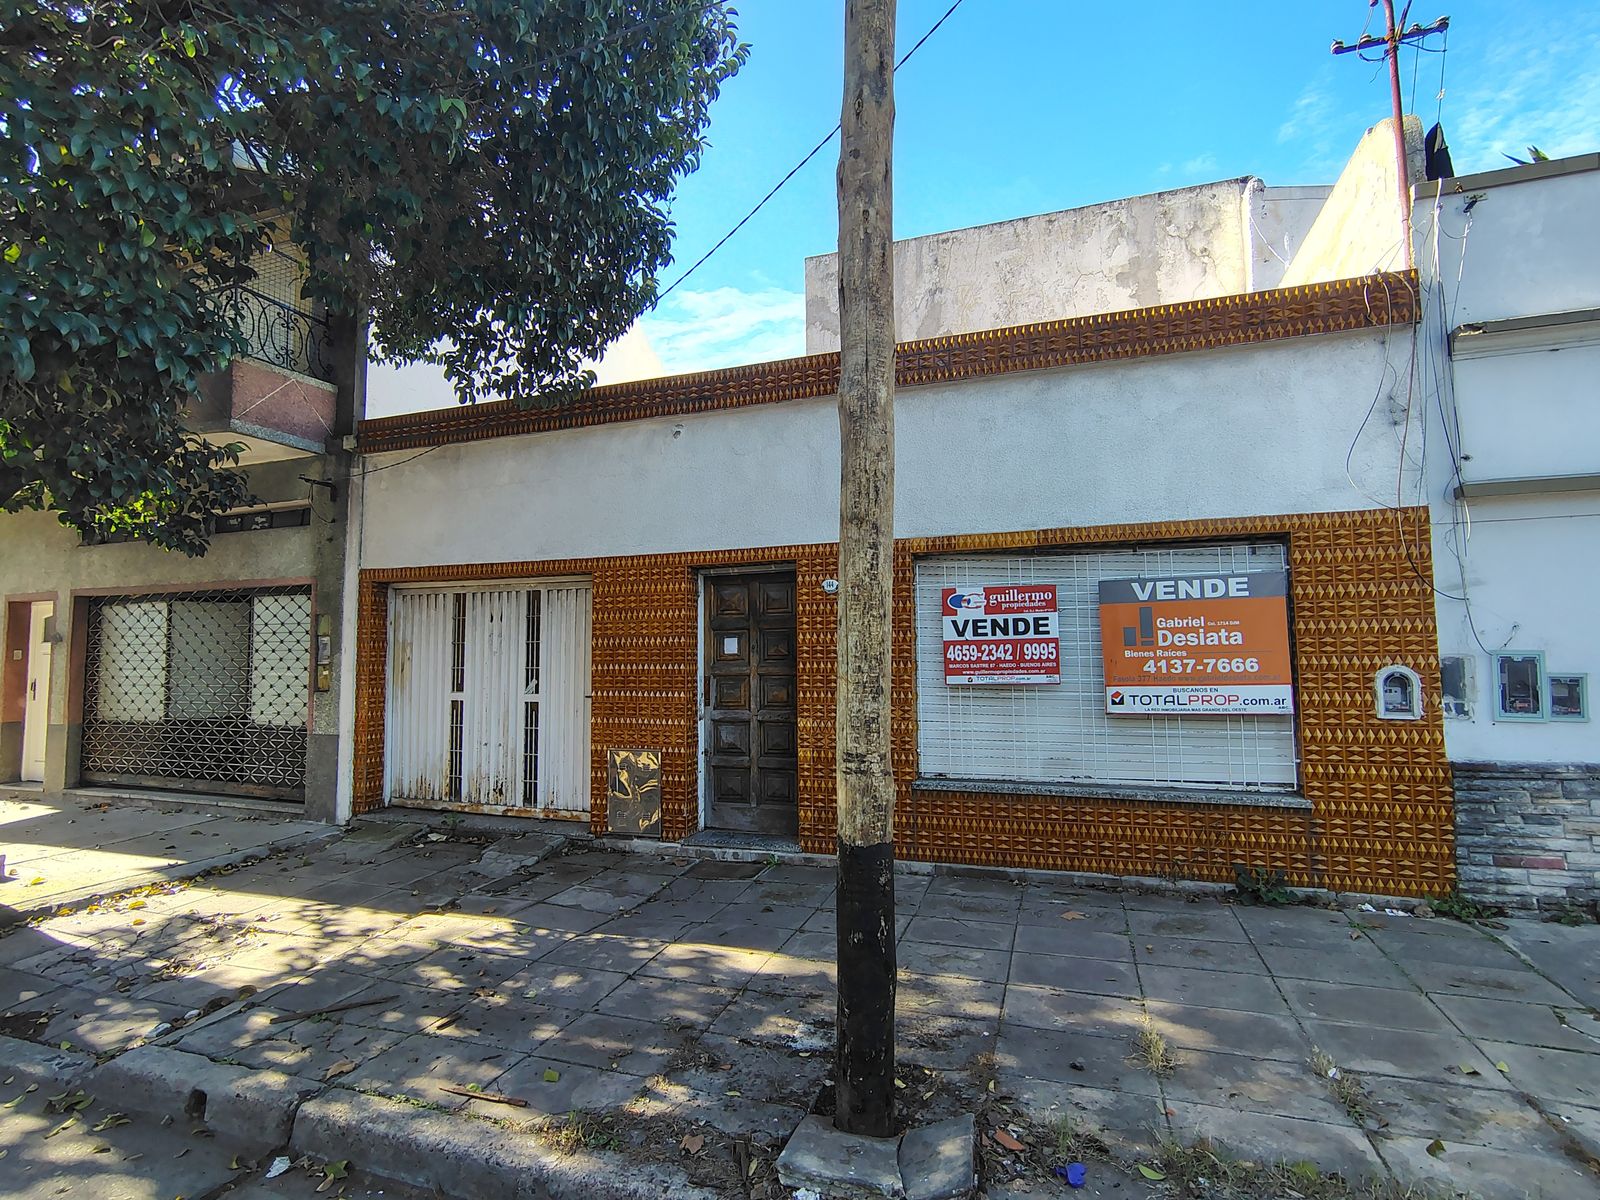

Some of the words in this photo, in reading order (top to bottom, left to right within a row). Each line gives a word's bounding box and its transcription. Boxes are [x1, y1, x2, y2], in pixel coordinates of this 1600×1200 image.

[989, 588, 1053, 607] guillermo
[1131, 577, 1250, 601] VENDE
[1001, 600, 1047, 610] propiedades
[950, 616, 1051, 637] VENDE
[1156, 616, 1205, 628] Gabriel
[1157, 628, 1243, 647] Desiata
[946, 643, 1013, 661] 4659-2342
[1023, 642, 1057, 660] 9995
[1124, 649, 1155, 658] Bienes
[1156, 648, 1187, 658] Raíces
[1142, 657, 1260, 674] 4137-7666
[1129, 694, 1287, 706] TOTALPROP.com.ar
